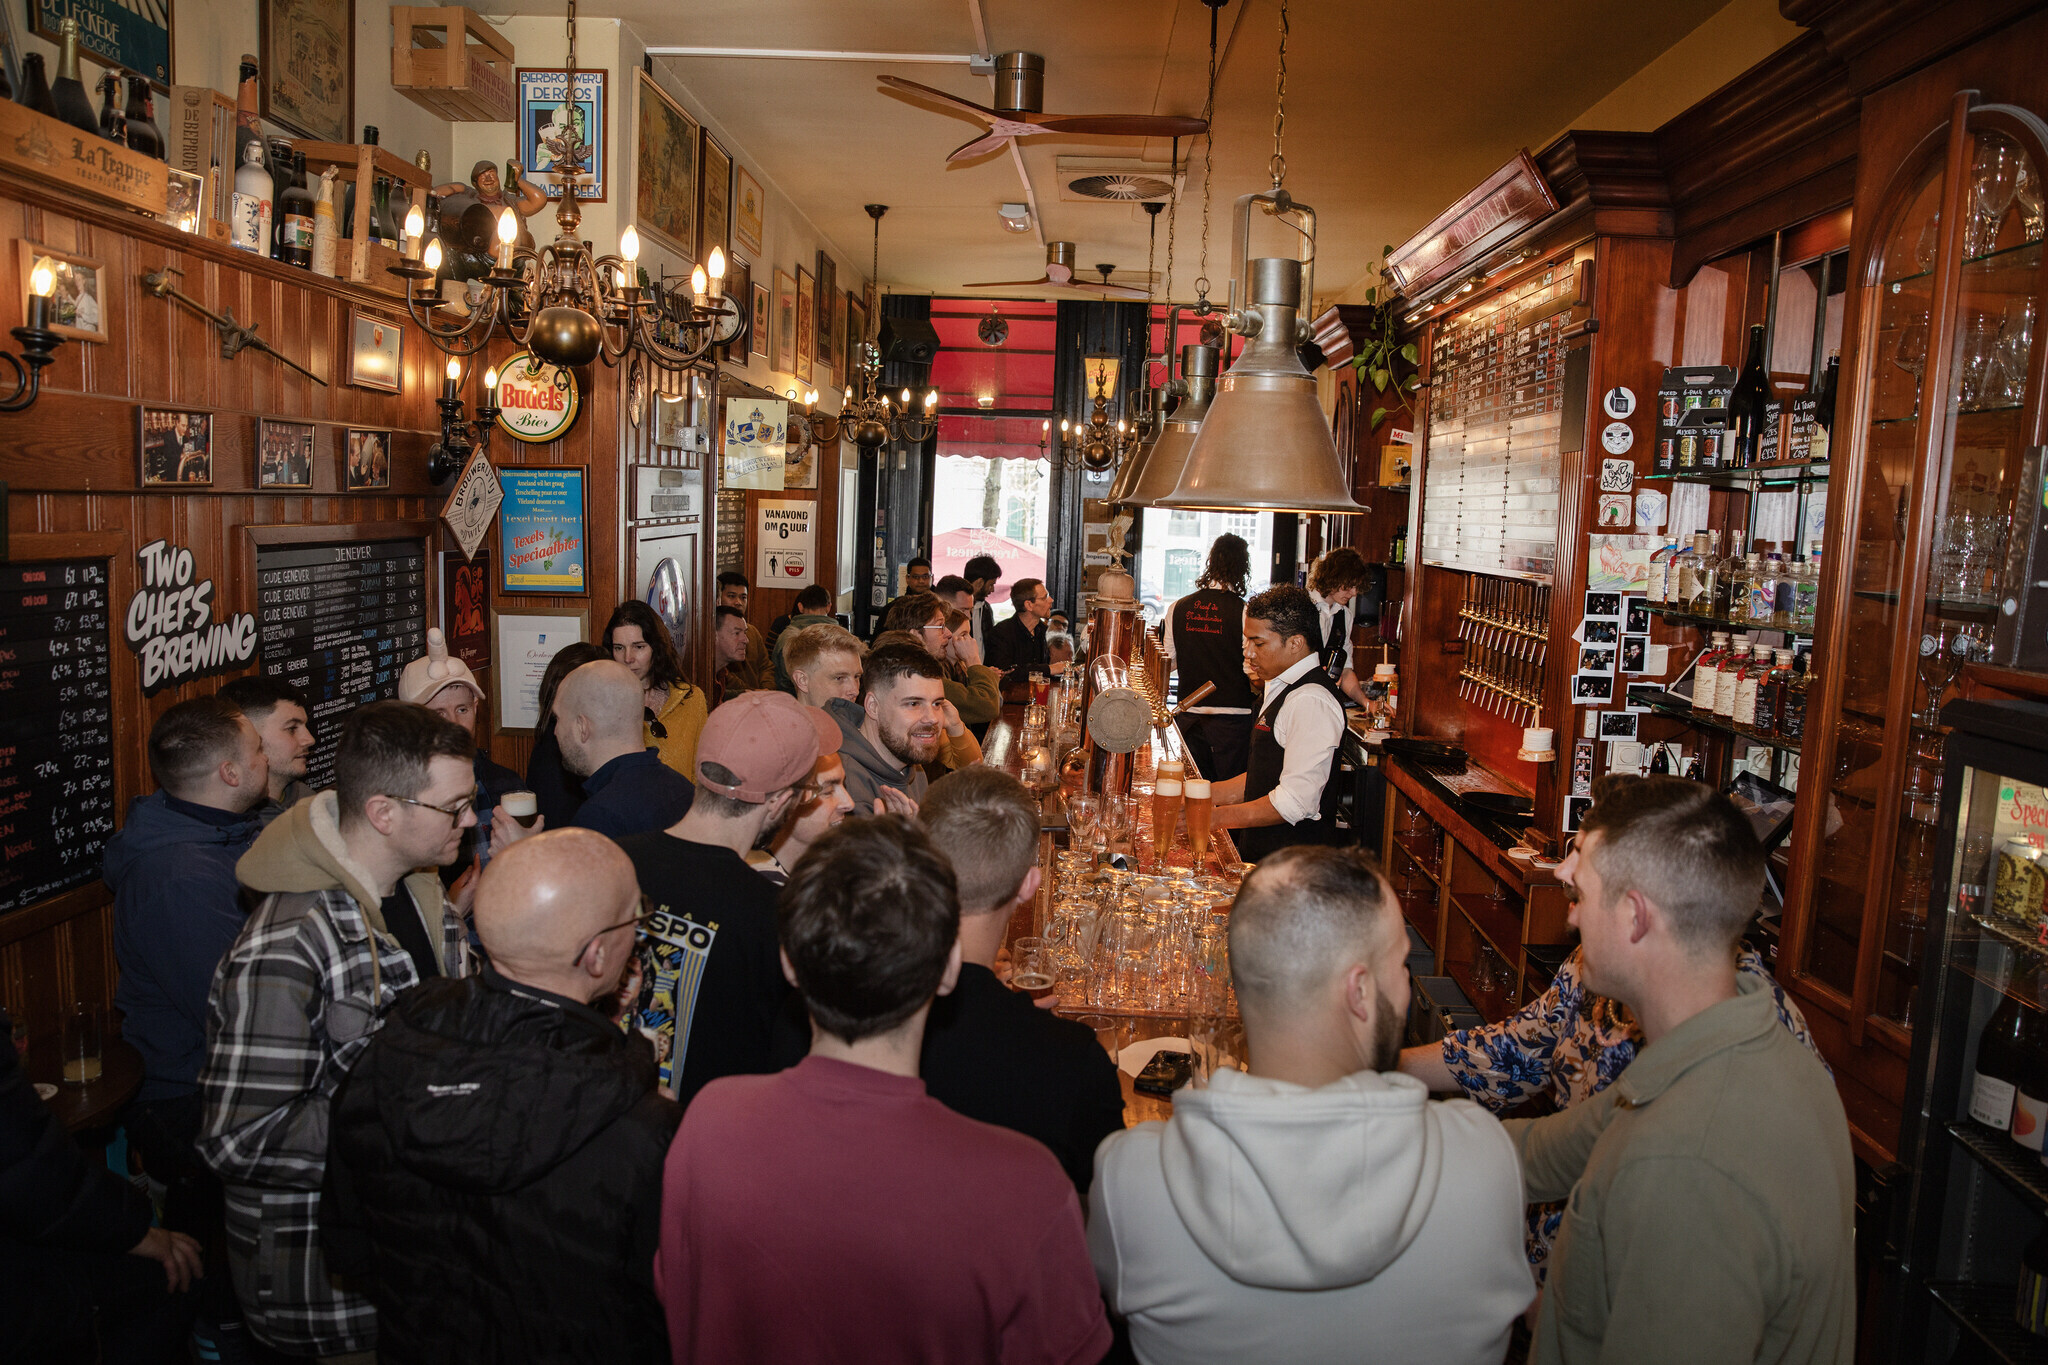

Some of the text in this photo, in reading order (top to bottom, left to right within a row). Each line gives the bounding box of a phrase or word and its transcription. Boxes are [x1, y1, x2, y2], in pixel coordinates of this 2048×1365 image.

[521, 72, 603, 85] BIERBROWERIJ
[533, 87, 592, 100] DE ROOS
[72, 138, 96, 166] La
[96, 146, 153, 186] Trappe
[1454, 190, 1513, 247] ON DRAFT
[502, 383, 564, 412] Budels
[515, 412, 549, 428] Bier
[456, 462, 490, 507] BROUWERIJ
[504, 514, 531, 523] Texel
[533, 514, 559, 523] heeft
[561, 515, 577, 523] het
[765, 509, 808, 520] VANAVOND
[512, 529, 545, 549] Texels
[764, 522, 808, 539] OM 6 UUR
[139, 540, 193, 588] TWO
[335, 545, 372, 562] JENEVER
[508, 538, 580, 569] Speciaalbier
[127, 580, 212, 642] CHEFS
[140, 613, 258, 688] BREWING
